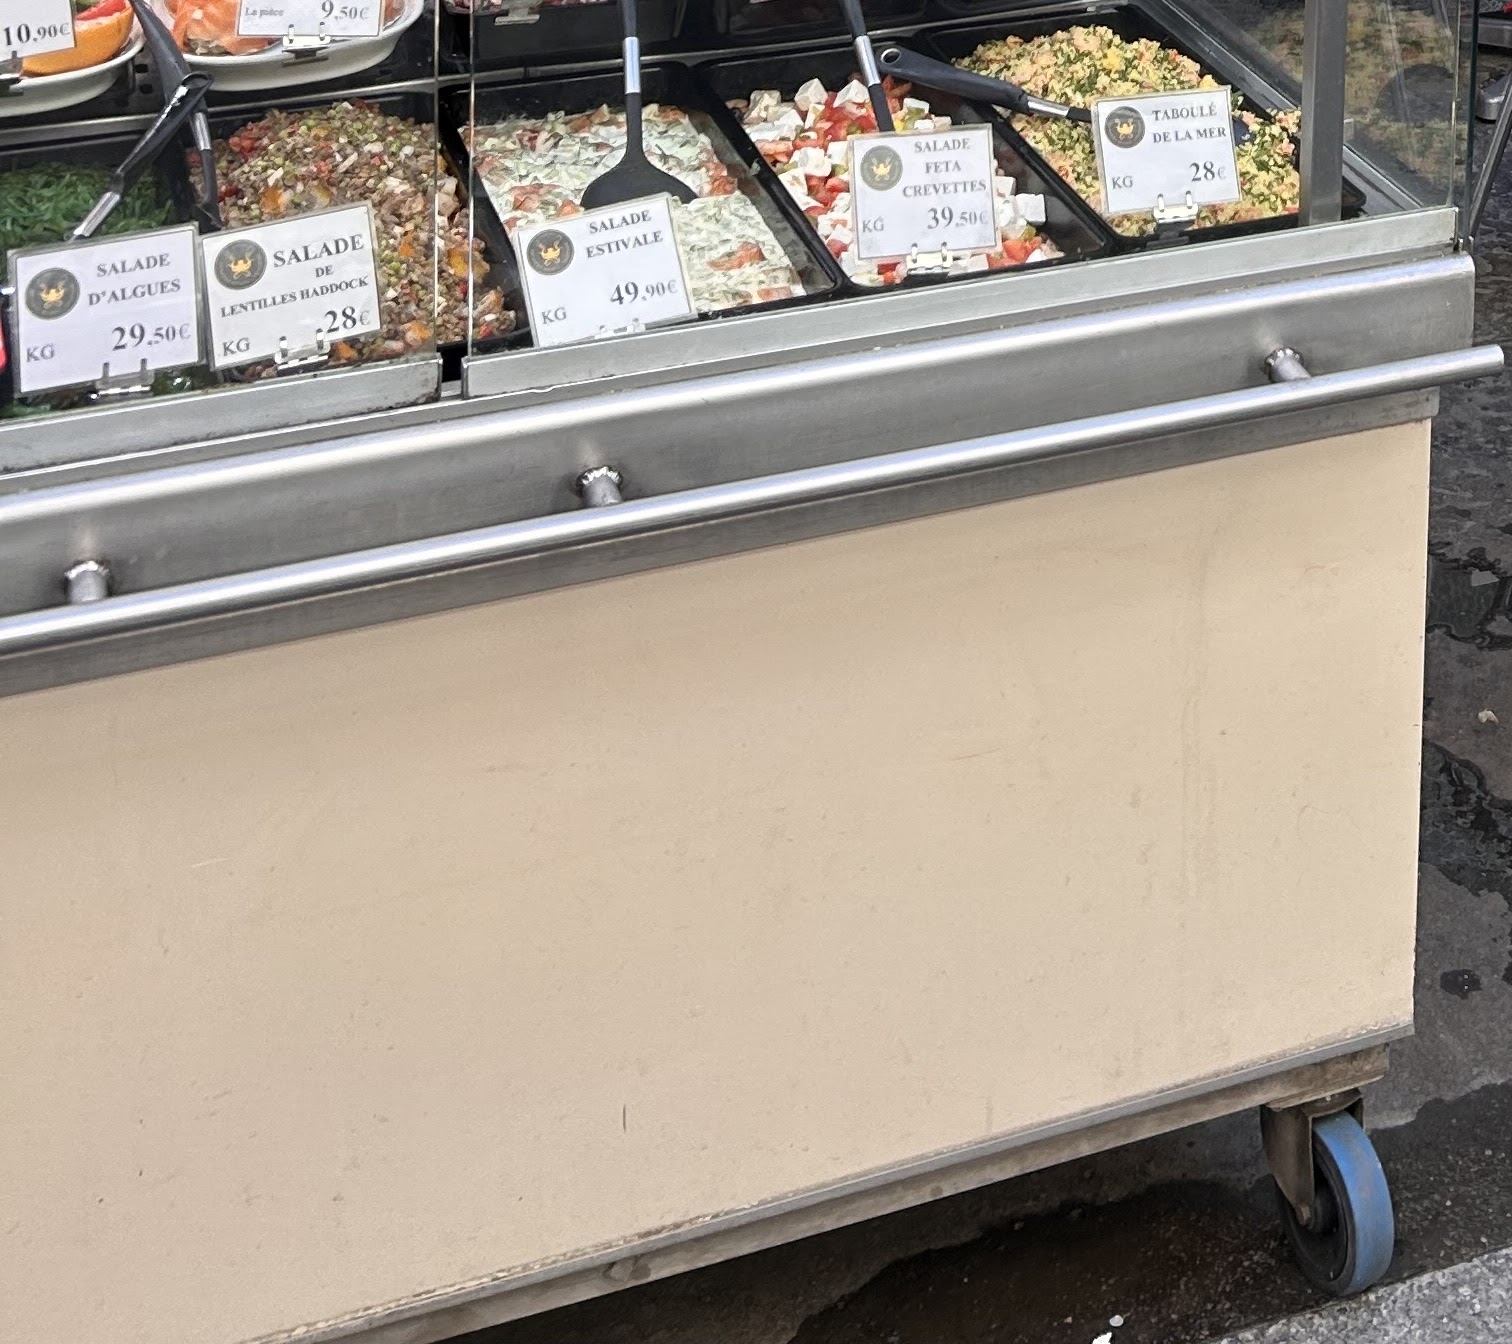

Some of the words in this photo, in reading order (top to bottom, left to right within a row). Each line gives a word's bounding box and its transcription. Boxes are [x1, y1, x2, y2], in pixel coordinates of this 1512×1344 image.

[1152, 102, 1218, 122] TABOULÉ
[1153, 132, 1172, 144] DE
[1175, 130, 1193, 141] LA
[1196, 126, 1227, 139] MER
[914, 137, 971, 153] SALADE
[925, 160, 962, 174] FETA
[902, 179, 987, 198] CREVETTES
[1111, 175, 1133, 190] KG
[589, 209, 652, 235] SALADE
[862, 216, 884, 234] KG
[273, 233, 365, 268] SALADE
[585, 230, 664, 259] ESTIVALE
[96, 253, 171, 278] SALADE
[315, 265, 334, 278] DE
[220, 291, 298, 318] LENTILLES
[299, 275, 369, 300] HADDOCK
[541, 307, 567, 325] KG
[26, 343, 55, 362] KG
[222, 337, 250, 357] KG
